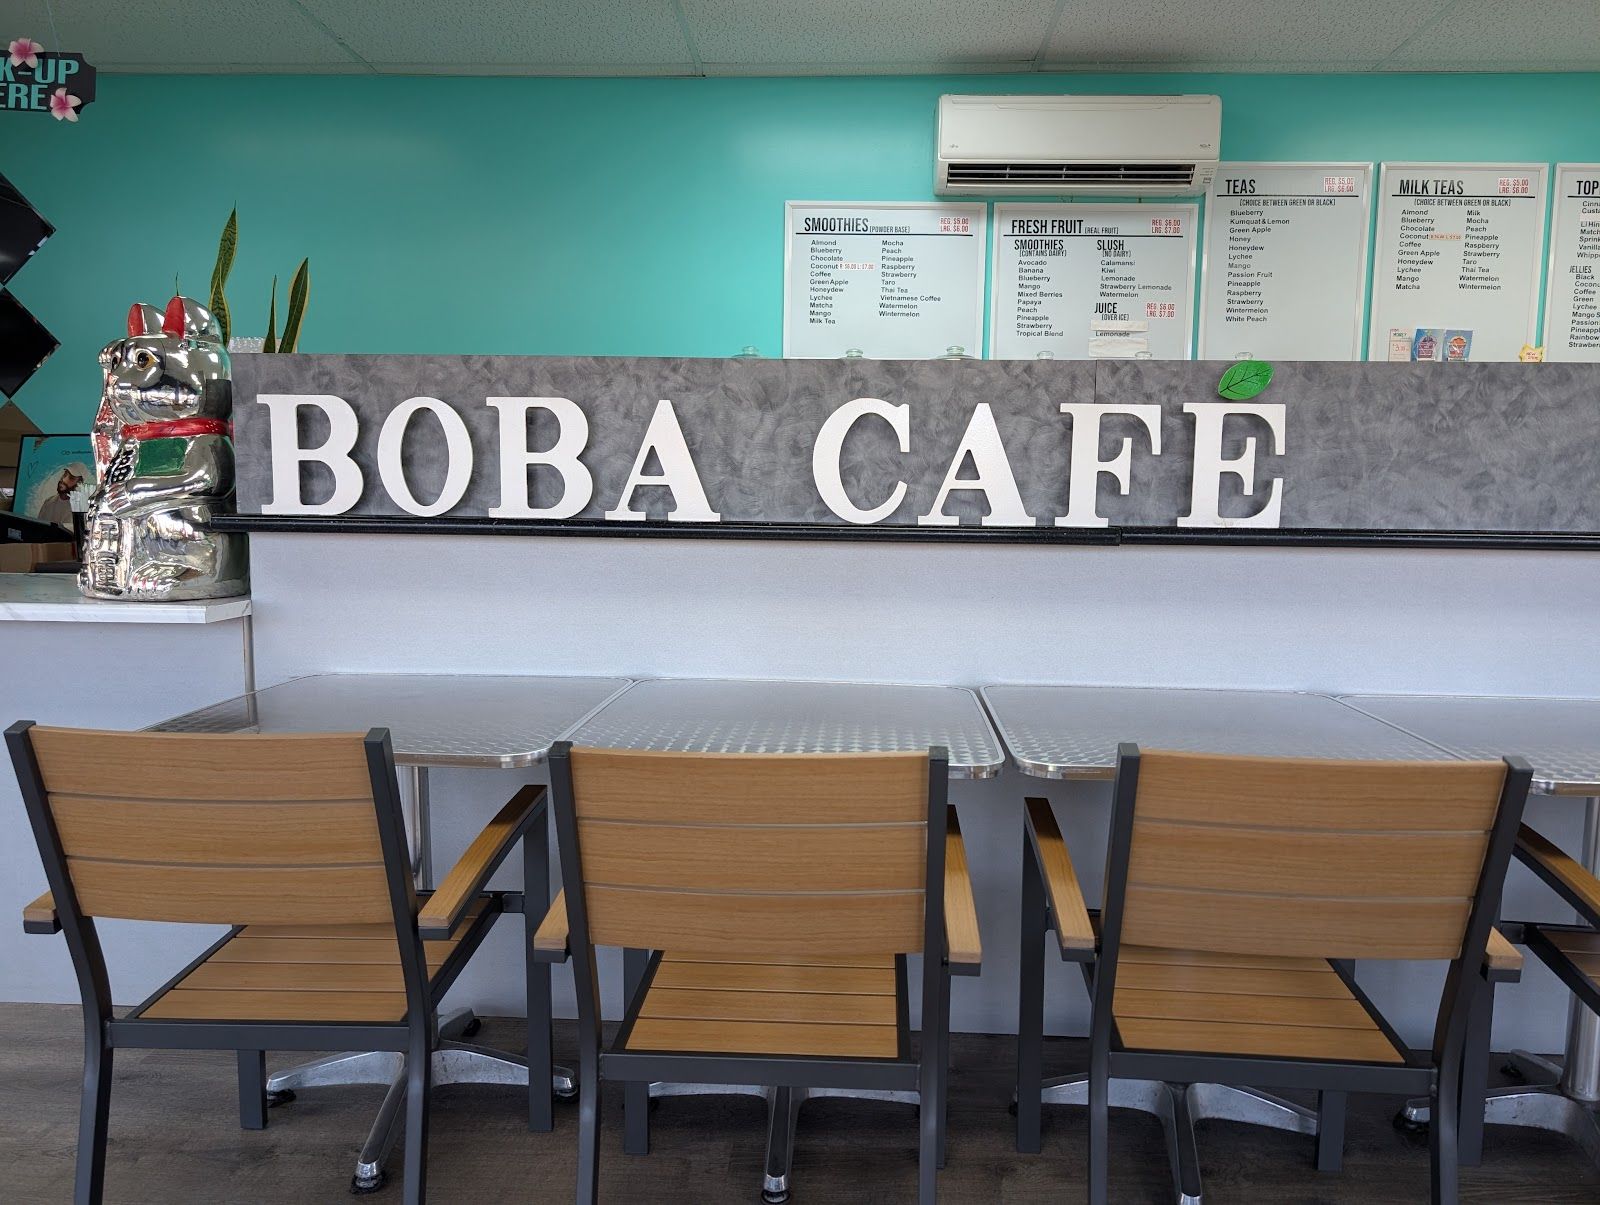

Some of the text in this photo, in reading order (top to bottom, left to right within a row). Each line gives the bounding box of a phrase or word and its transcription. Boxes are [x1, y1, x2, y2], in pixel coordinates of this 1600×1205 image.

[1225, 179, 1256, 194] TEAS
[1400, 180, 1464, 194] MILK TEAS
[1513, 179, 1529, 187] $5.00
[1577, 181, 1600, 195] TOP
[804, 218, 869, 232] SMOOTHIES
[1012, 220, 1047, 233] FRESH
[1052, 220, 1083, 234] FRUIT
[1014, 239, 1064, 250] SMOOTHIES
[1097, 240, 1124, 251] SLUSH
[1095, 303, 1117, 314] JUICE
[256, 393, 721, 522] BOBA
